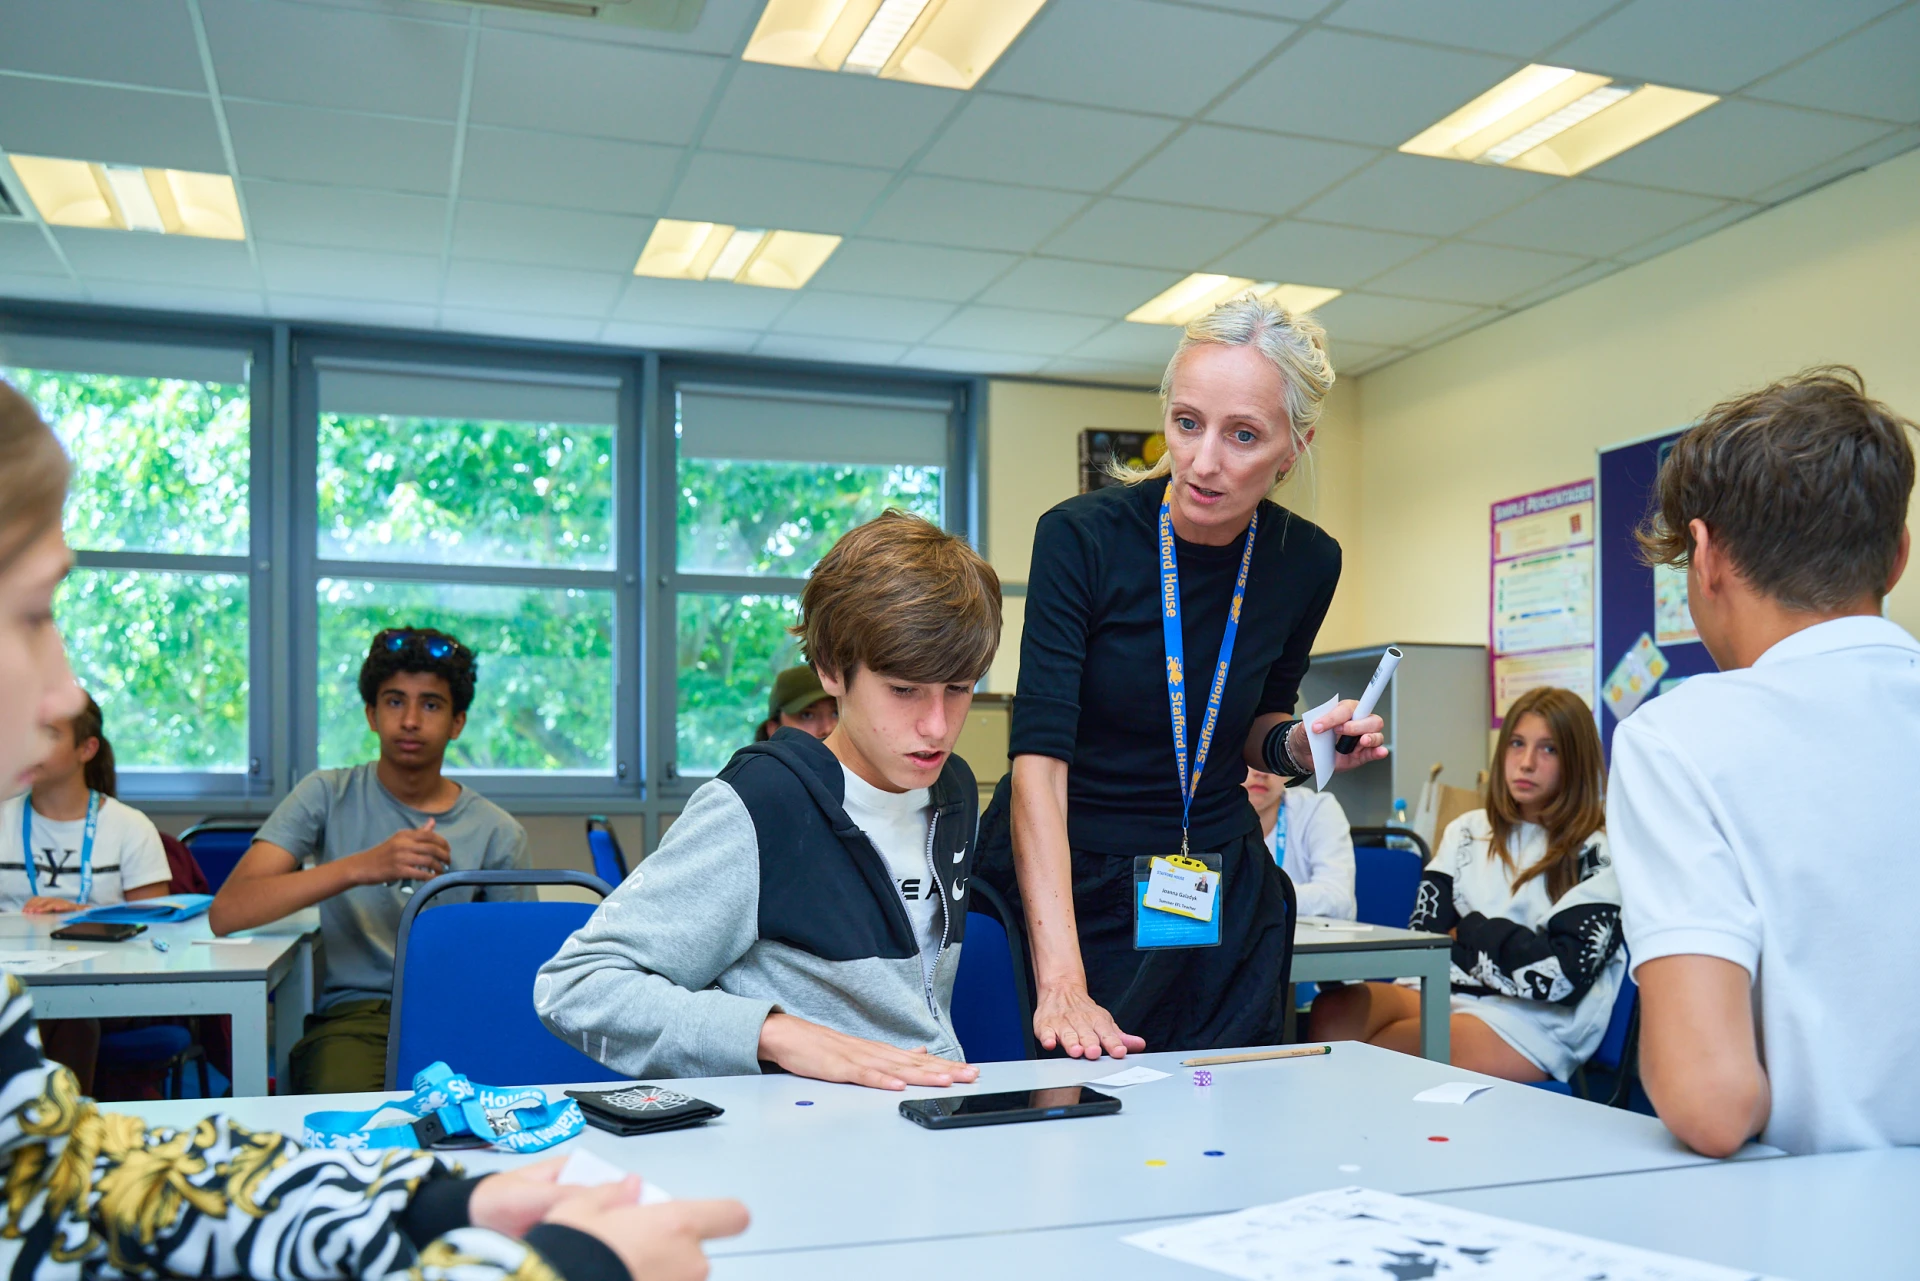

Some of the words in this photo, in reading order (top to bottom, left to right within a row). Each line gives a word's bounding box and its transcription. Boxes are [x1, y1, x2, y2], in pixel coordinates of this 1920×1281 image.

[1160, 511, 1177, 570] Stafford
[1237, 531, 1256, 588] Stafford
[1163, 572, 1177, 618] House
[1171, 692, 1187, 749] Stafford
[1197, 708, 1218, 764] Stafford
[1209, 661, 1228, 705] House
[1162, 888, 1178, 897] Joanna
